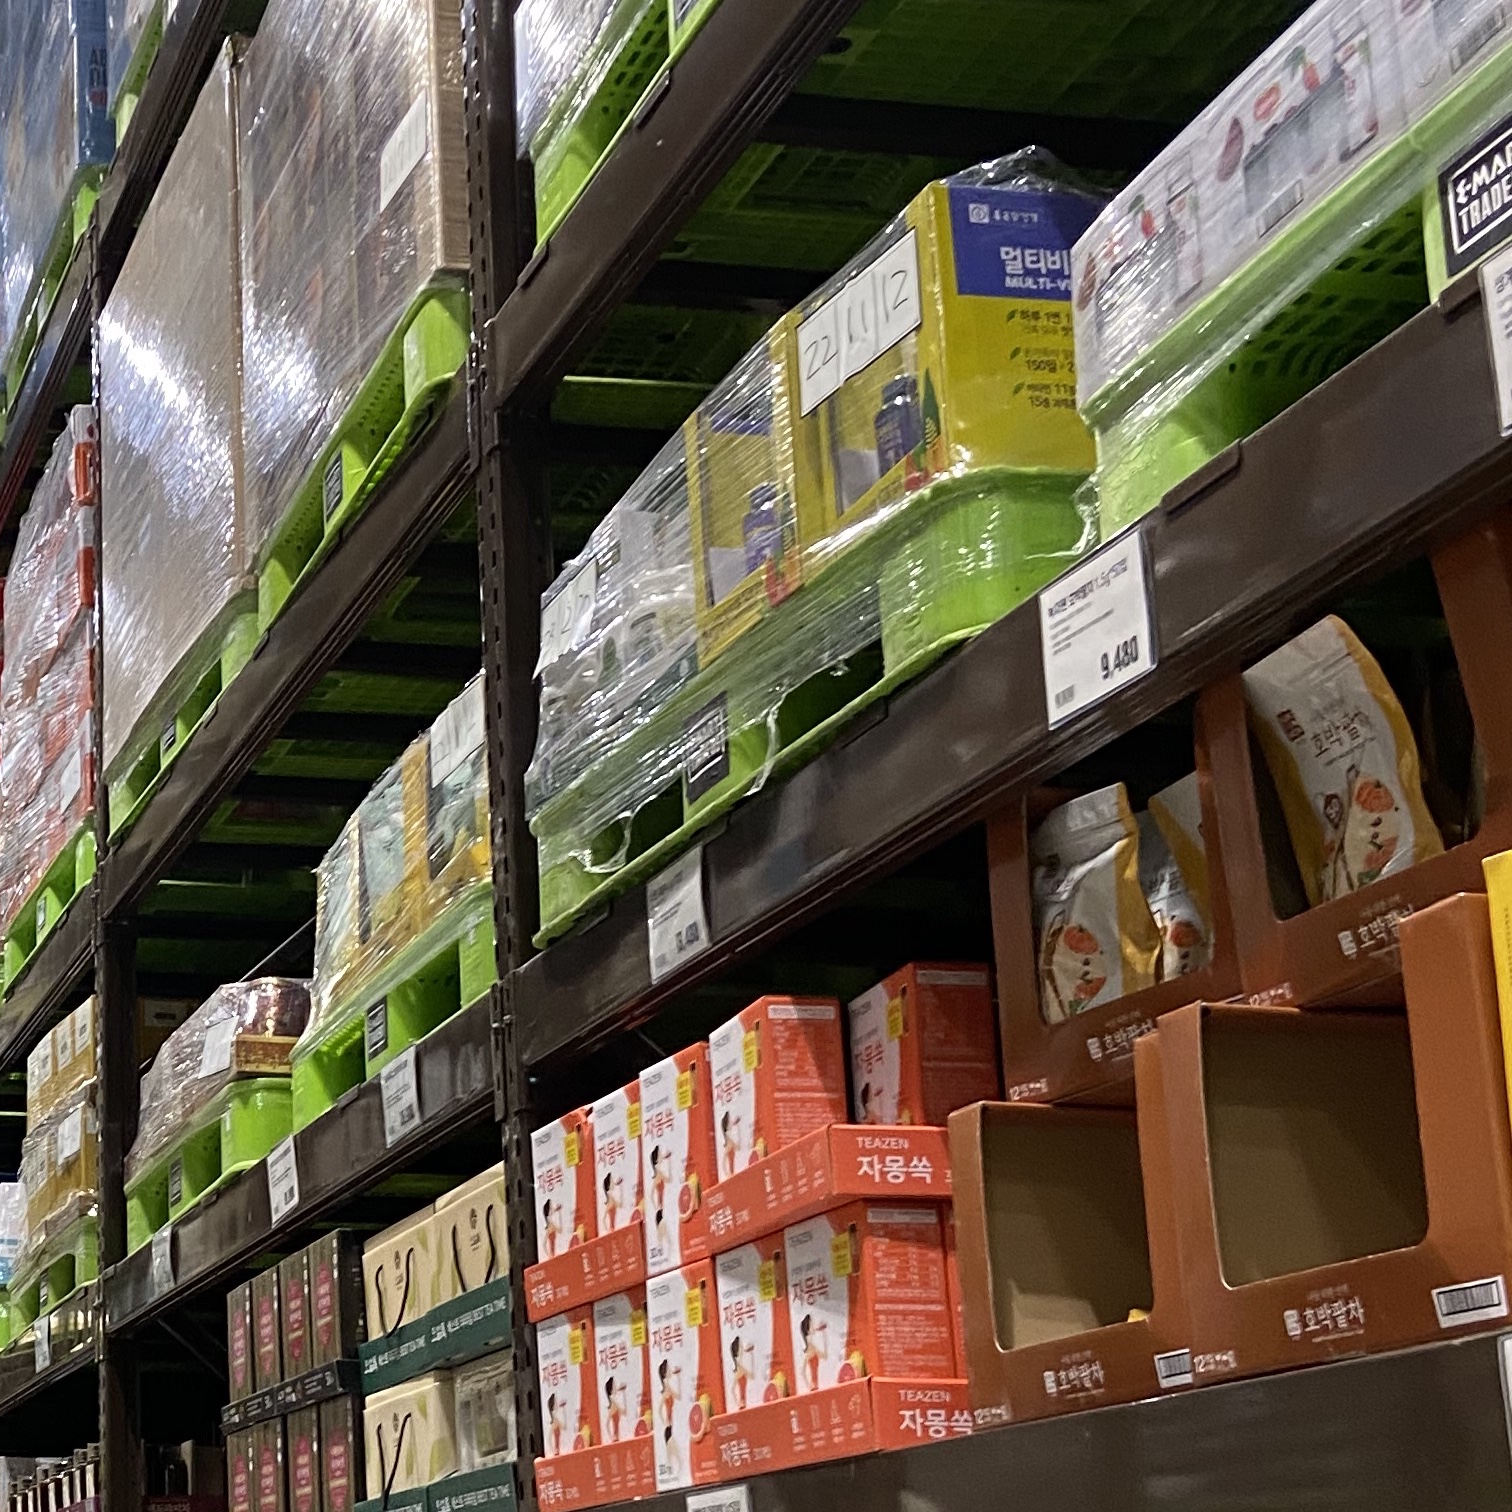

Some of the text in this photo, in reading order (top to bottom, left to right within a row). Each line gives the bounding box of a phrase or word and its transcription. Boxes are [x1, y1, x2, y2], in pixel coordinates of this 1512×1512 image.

[1101, 635, 1139, 681] 9,480
[856, 1137, 909, 1149] TEAZEN
[857, 1154, 933, 1184] 자몽쏙
[898, 1390, 951, 1403] TEAZEN
[899, 1408, 974, 1438] 자몽쏙
